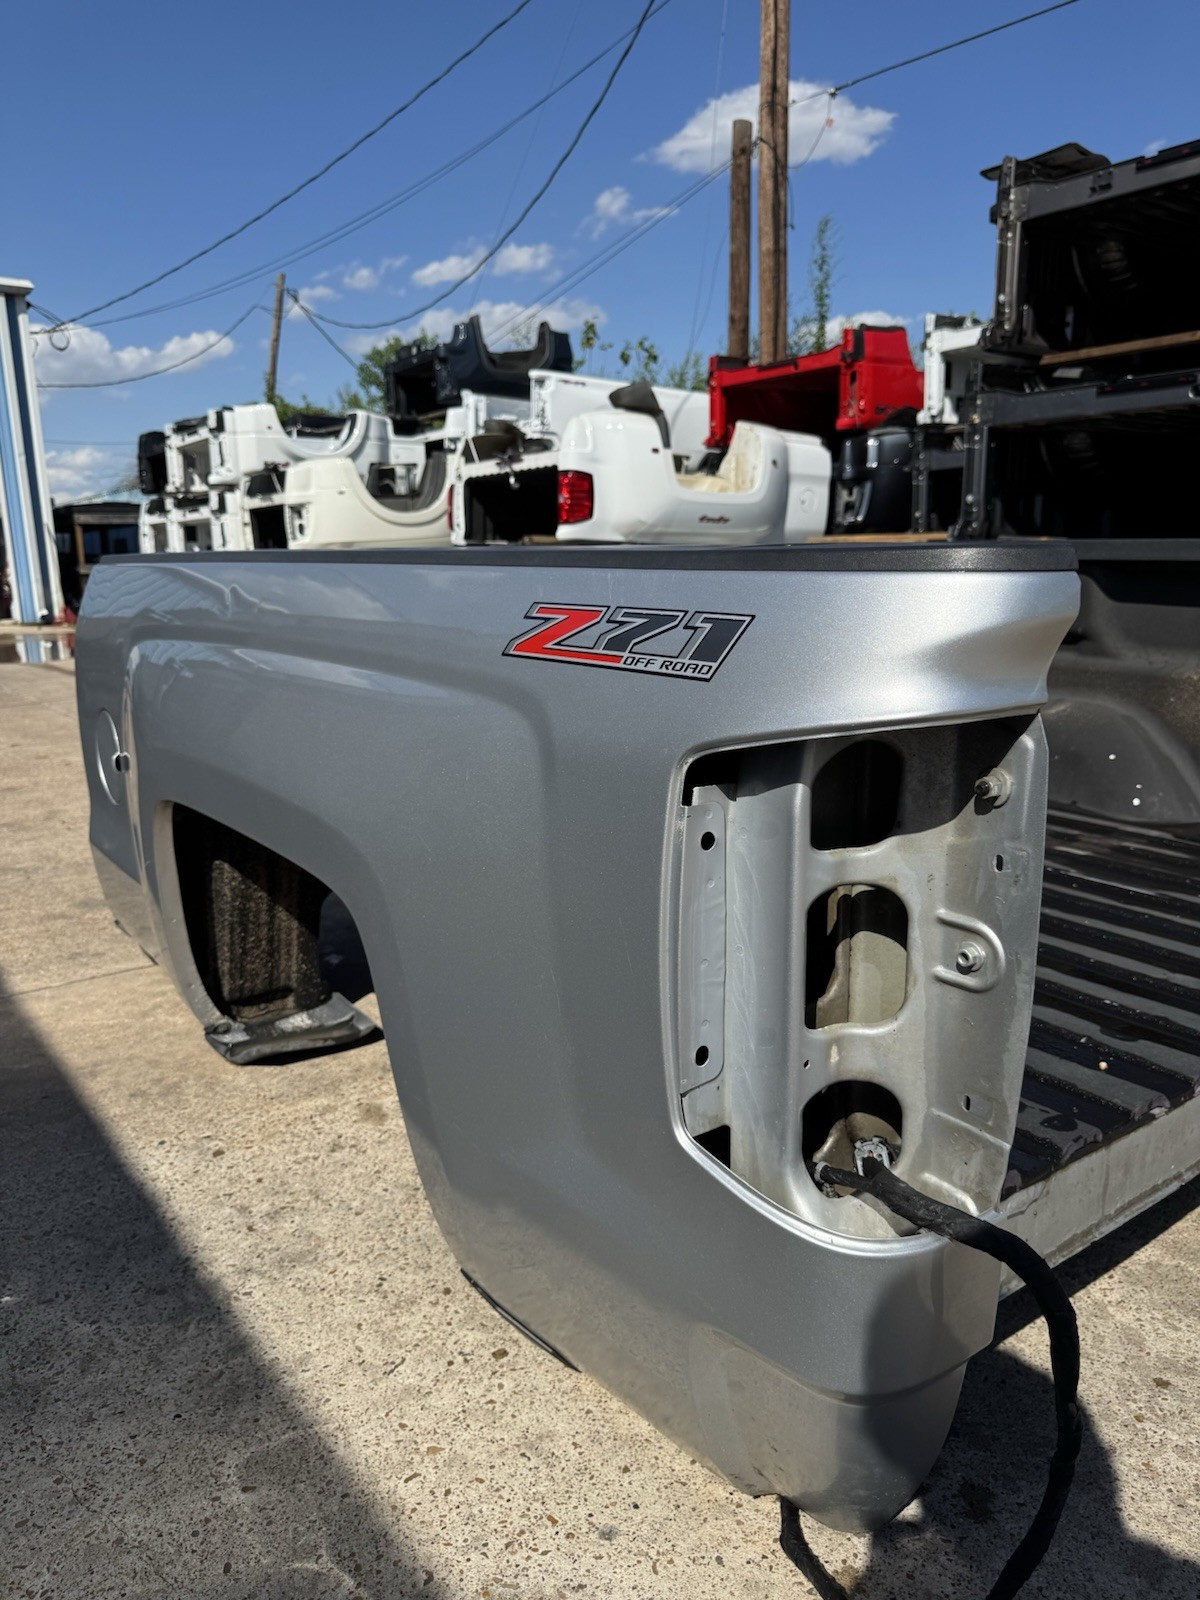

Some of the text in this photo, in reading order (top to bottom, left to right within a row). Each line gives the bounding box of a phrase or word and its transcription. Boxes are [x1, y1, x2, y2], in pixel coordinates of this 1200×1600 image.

[502, 602, 756, 682] Z71
[623, 655, 713, 675] OFF ROAD
